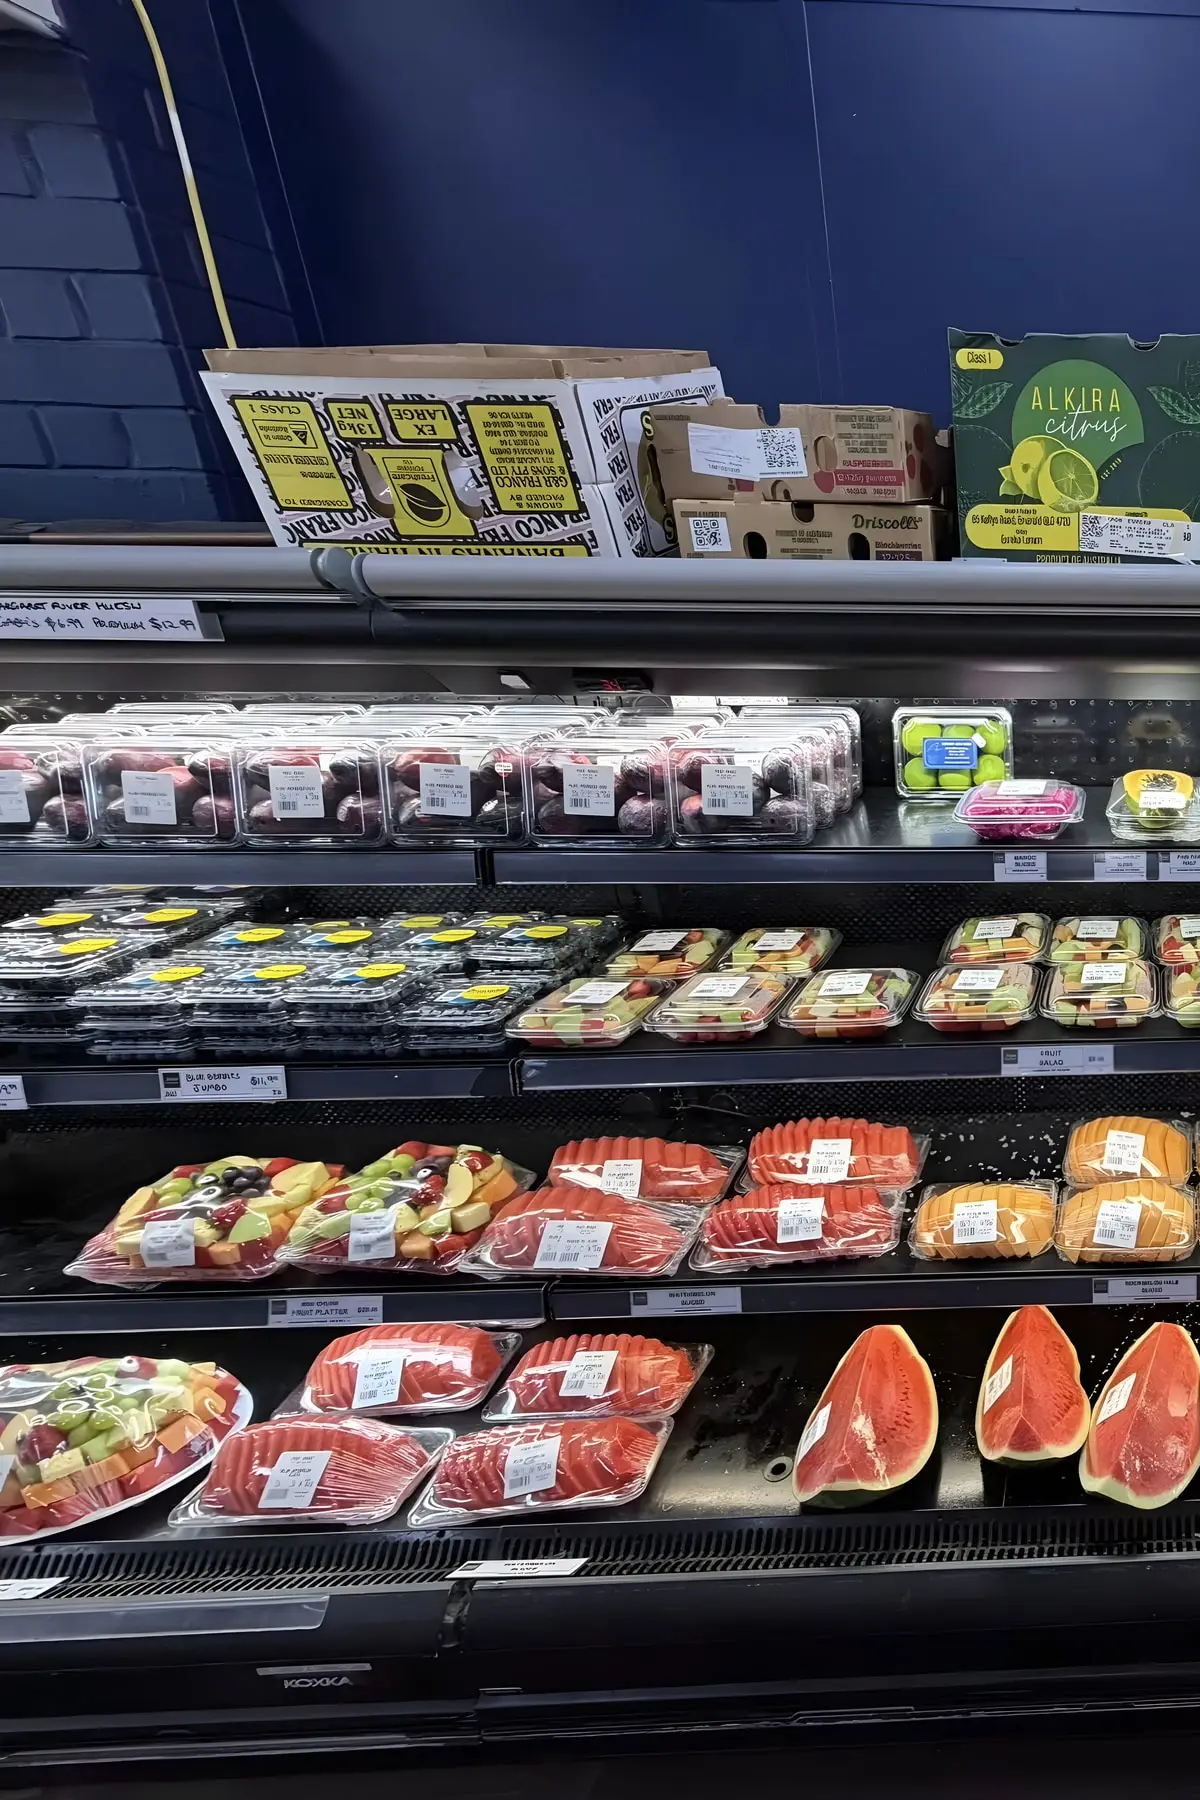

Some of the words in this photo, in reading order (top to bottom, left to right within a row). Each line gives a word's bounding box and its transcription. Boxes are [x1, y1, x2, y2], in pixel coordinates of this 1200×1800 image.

[966, 352, 987, 364] Class
[1031, 386, 1121, 412] ALKIRA
[260, 404, 301, 415] CLASS
[337, 407, 366, 420] NET
[391, 408, 446, 420] LARGE
[337, 420, 377, 435] 13kg
[412, 423, 437, 436] EX
[1045, 404, 1128, 442] citrus
[490, 466, 508, 476] LTD
[510, 465, 528, 476] PTY
[530, 465, 556, 476] SONS
[558, 465, 566, 475] &
[495, 475, 541, 488] FRANCO
[542, 475, 568, 488] G&R
[0, 602, 47, 611] ARGARET
[51, 602, 91, 611] RIVER
[45, 616, 85, 632] $6.99
[149, 617, 196, 632] $12.99
[284, 1676, 354, 1689] KOXKA
